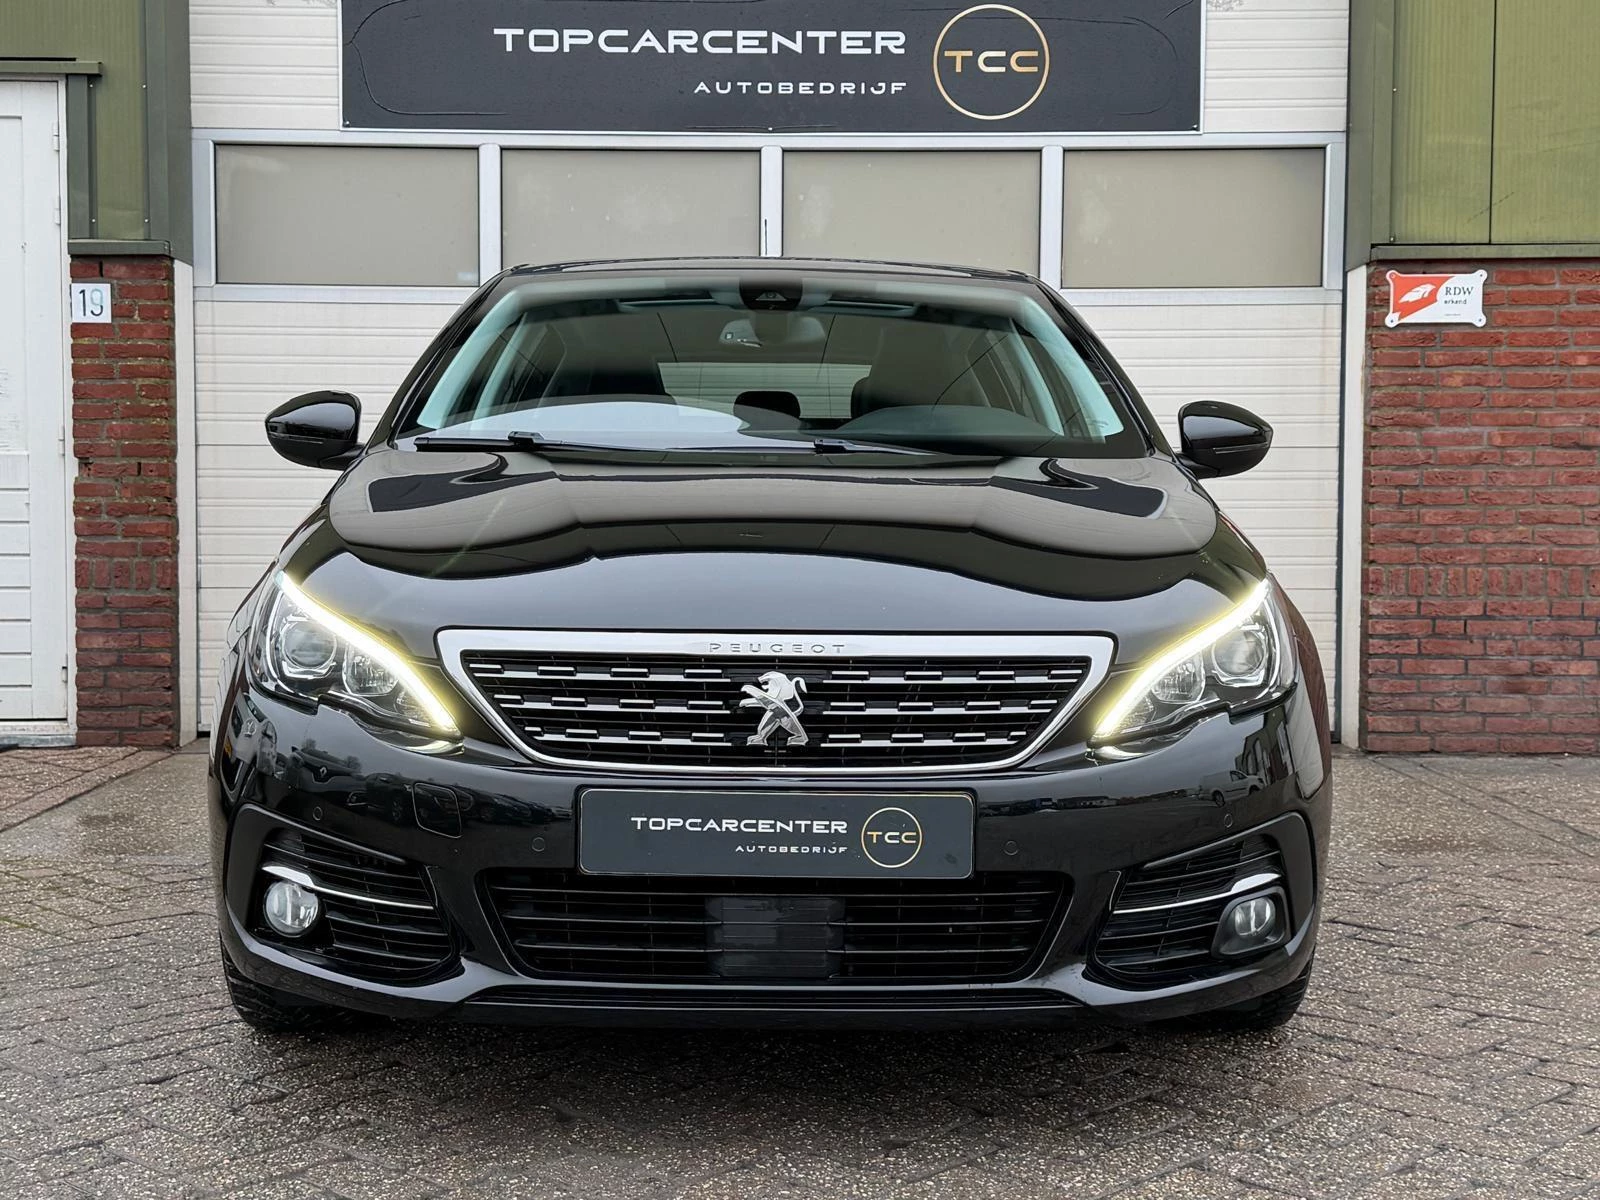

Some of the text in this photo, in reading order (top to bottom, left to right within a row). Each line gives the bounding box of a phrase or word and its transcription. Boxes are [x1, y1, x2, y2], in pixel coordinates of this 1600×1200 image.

[493, 27, 906, 55] TOPCARCENTER
[943, 49, 1039, 73] TCC
[693, 80, 907, 95] AUTOBEDRIJF
[1444, 286, 1474, 296] RDW
[78, 287, 104, 317] 19
[708, 642, 845, 654] PEUGEOT
[630, 816, 848, 834] TOPCARCENTER
[866, 830, 917, 844] TCC
[735, 844, 848, 854] AUTOBEDRIJF
